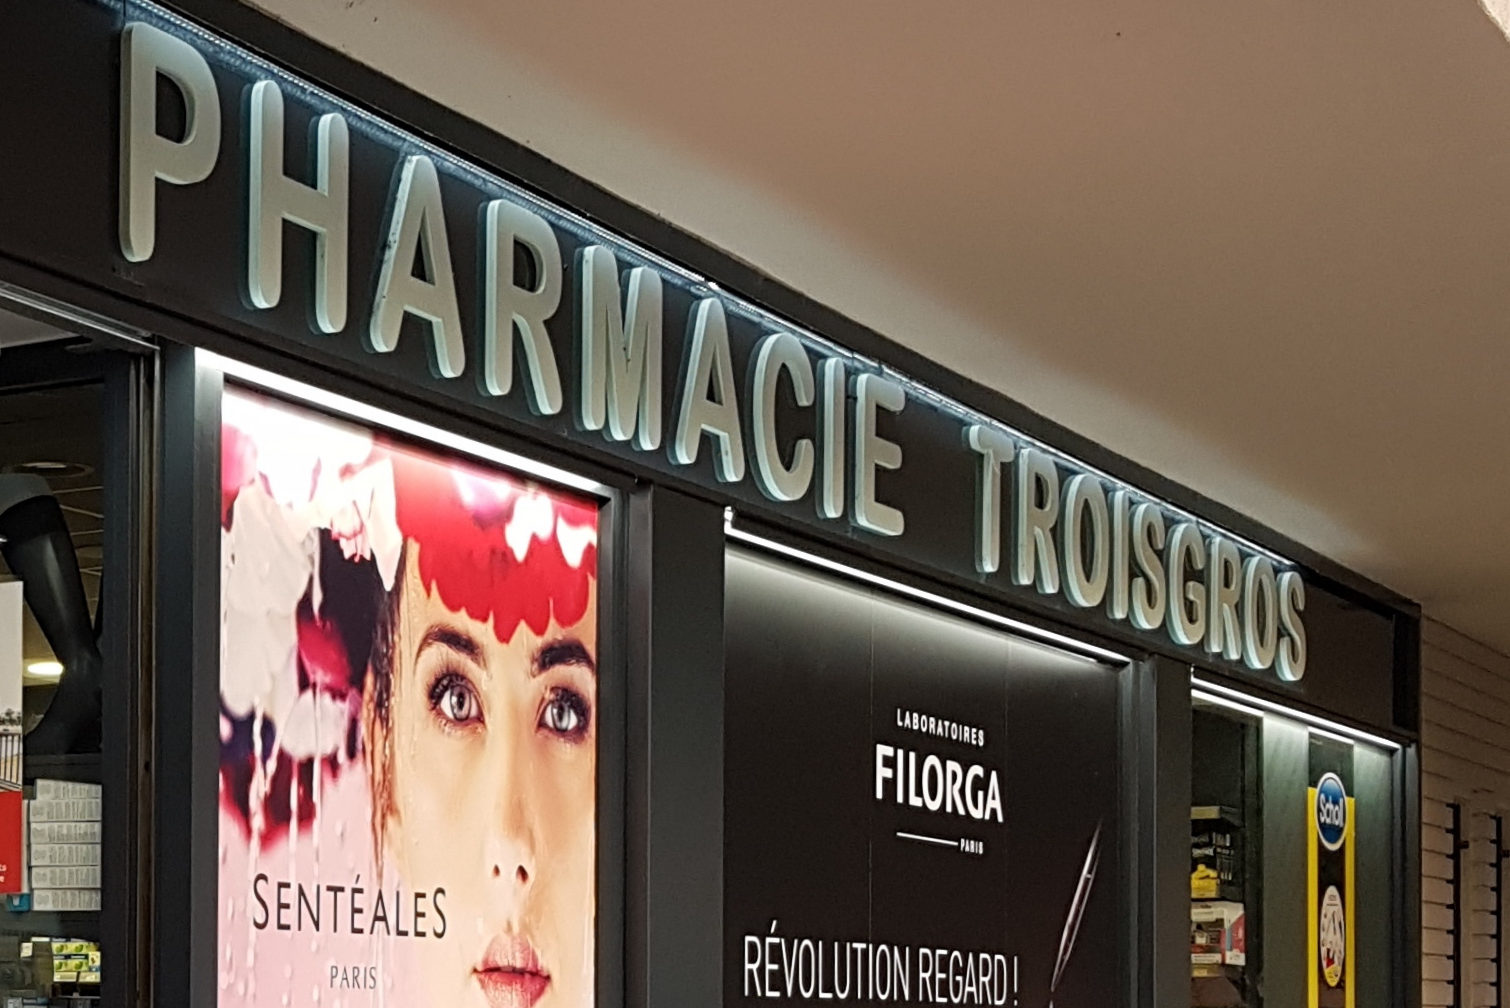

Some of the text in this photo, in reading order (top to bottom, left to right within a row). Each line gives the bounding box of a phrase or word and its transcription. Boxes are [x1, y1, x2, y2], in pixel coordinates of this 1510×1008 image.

[120, 21, 1306, 681] PHARMACIE TROISGROS
[897, 708, 984, 747] LABORATOIRES
[876, 743, 1003, 823] FILORGA
[1319, 792, 1343, 828] Scholl
[961, 838, 983, 854] PARIS
[253, 874, 447, 939] SENTÉALES
[330, 965, 377, 990] PARIS
[744, 920, 909, 1001] RÉVOLUTION
[919, 948, 1007, 1006] REGARD
